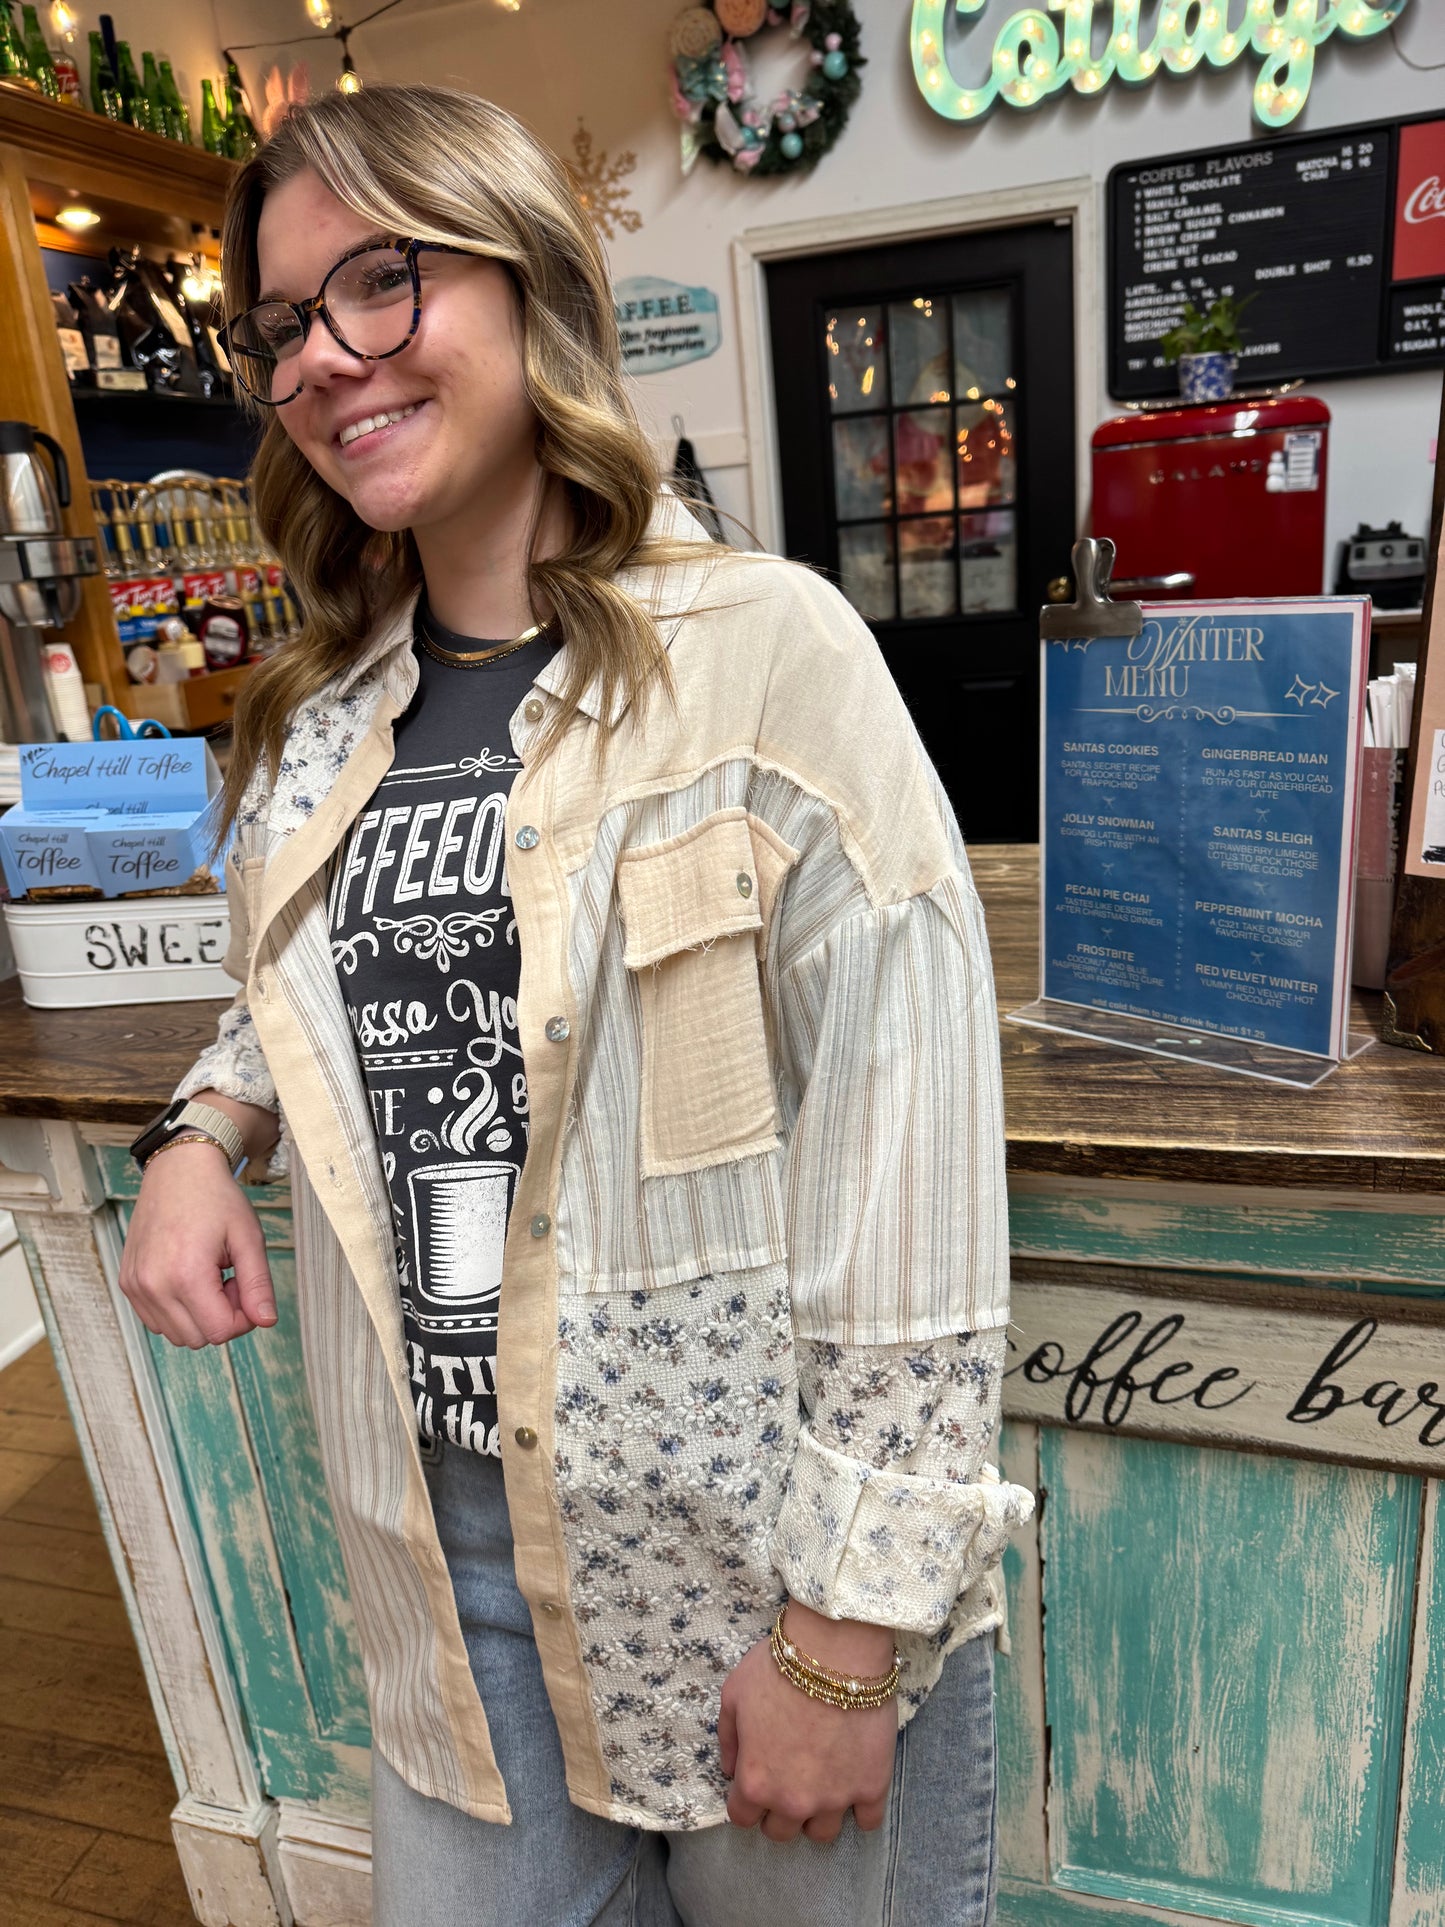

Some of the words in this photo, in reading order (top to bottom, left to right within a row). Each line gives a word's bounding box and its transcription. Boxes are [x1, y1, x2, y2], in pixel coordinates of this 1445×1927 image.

[1139, 164, 1196, 185] COFFEE
[1206, 152, 1274, 174] FLAVORS
[1296, 156, 1339, 172] MATCHA
[1302, 169, 1330, 182] CHAI
[1143, 184, 1176, 199] WHITE
[1179, 174, 1242, 193] CHOCOLATE
[1144, 196, 1188, 211] VANILLA
[1144, 211, 1171, 224] SALT
[1174, 203, 1224, 219] CARAMEL
[1144, 222, 1181, 236] BROWN
[1185, 216, 1222, 230] SUGAR
[1228, 206, 1286, 224] CINNAMON
[1143, 236, 1176, 249] IRISH
[1180, 229, 1217, 243] CREAM
[1143, 260, 1179, 273] CREME
[1184, 256, 1199, 268] DE
[1202, 250, 1239, 265] CACAO
[1255, 265, 1297, 280] DOUBLE
[1303, 259, 1331, 274] SHOT
[1238, 343, 1282, 358] LAVORS
[1402, 338, 1437, 352] SUGAR
[1127, 614, 1265, 671] WINTER
[1104, 665, 1190, 697] MENU
[1064, 742, 1105, 753] SANTAS
[1108, 744, 1159, 756] COOKIES
[1202, 748, 1294, 763] GINGERBREAD
[1298, 753, 1328, 764] MAN
[32, 756, 95, 785] Chapel
[97, 754, 133, 778] Hill
[137, 752, 193, 781] Toffee
[1061, 760, 1091, 769] SANTAS
[1094, 762, 1126, 771] SECRET
[1129, 764, 1160, 773] RECIPE
[1065, 769, 1081, 777] FOR
[1091, 771, 1121, 779] COOKIE
[1125, 772, 1156, 781] DOUGH
[1206, 768, 1225, 776] RUN
[1228, 770, 1240, 778] AS
[1243, 770, 1266, 779] FAST
[1269, 772, 1281, 780] AS
[1284, 773, 1304, 782] YOU
[1307, 774, 1328, 783] CAN
[1201, 777, 1213, 785] TO
[1216, 778, 1233, 786] TRY
[1236, 779, 1256, 788] OUR
[1260, 781, 1333, 793] GINGERBREAD
[1250, 790, 1279, 799] LATTE
[127, 801, 149, 814] Hill
[1063, 814, 1094, 824] JOLLY
[1098, 816, 1154, 830] SNOWMAN
[18, 833, 51, 845] Chapel
[52, 833, 69, 844] Hill
[112, 838, 145, 850] Chapel
[147, 836, 166, 848] Hill
[1061, 827, 1095, 837] EGGNOG
[1098, 831, 1123, 840] LATTE
[1124, 833, 1145, 842] WITH
[1148, 836, 1159, 844] AN
[1085, 838, 1106, 847] IRISH
[1109, 841, 1134, 849] TWIST
[1214, 826, 1262, 840] SANTAS
[1266, 832, 1312, 845] SLEIGH
[1208, 842, 1272, 856] STRAWBERRY
[1275, 848, 1318, 860] LIMEADE
[1208, 851, 1237, 861] LOTUS
[1240, 854, 1252, 862] TO
[1256, 856, 1282, 866] ROCK
[1285, 859, 1318, 870] THOSE
[16, 848, 82, 877] Toffee
[109, 850, 180, 880] Toffee
[1222, 861, 1259, 873] FESTIVE
[1262, 866, 1303, 878] COLORS
[1066, 884, 1100, 897] PECAN
[1103, 889, 1120, 899] PIE
[1123, 892, 1149, 903] CHAI
[1056, 905, 1080, 913] AFTER
[1083, 907, 1128, 922] CHRISTMAS
[1131, 915, 1162, 927] DINNER
[1065, 897, 1093, 908] TASTES
[1095, 901, 1112, 910] LIKE
[1114, 903, 1153, 916] DESSERT
[1195, 901, 1272, 920] PEPPERMINT
[1276, 912, 1323, 928] MOCHA
[1216, 928, 1260, 941] FAVORITE
[1262, 935, 1302, 948] CLASSIC
[1242, 922, 1264, 932] TAKE
[1267, 926, 1281, 935] ON
[1284, 929, 1310, 939] YOUR
[85, 919, 226, 970] SWEE
[1077, 944, 1134, 961] FROSTBITE
[1053, 959, 1097, 974] RASPBERRY
[1100, 968, 1126, 978] LOTUS
[1129, 973, 1138, 981] TO
[1140, 976, 1164, 986] CURE
[1067, 954, 1105, 966] COCONUT
[1108, 962, 1124, 970] AND
[1127, 965, 1148, 975] BLUE
[1073, 971, 1094, 981] YOUR
[1096, 976, 1140, 990] FROSTBITE
[1196, 964, 1219, 976] RED
[1222, 968, 1266, 985] VELVET
[1269, 976, 1318, 993] WINTER
[1201, 978, 1233, 990] YUMMY
[1236, 984, 1255, 994] RED
[1258, 988, 1292, 1001] VELVET
[1294, 996, 1314, 1005] HOT
[1226, 992, 1282, 1008] CHOCOLATE
[1109, 1001, 1127, 1011] cold
[1152, 1010, 1160, 1018] to
[1163, 1013, 1178, 1023] any
[1181, 1015, 1204, 1026] drink
[1206, 1020, 1218, 1029] for
[1221, 1023, 1239, 1034] just
[1241, 1027, 1265, 1039] $1.25
[1003, 1310, 1257, 1428] offee
[1286, 1317, 1445, 1447] bar
